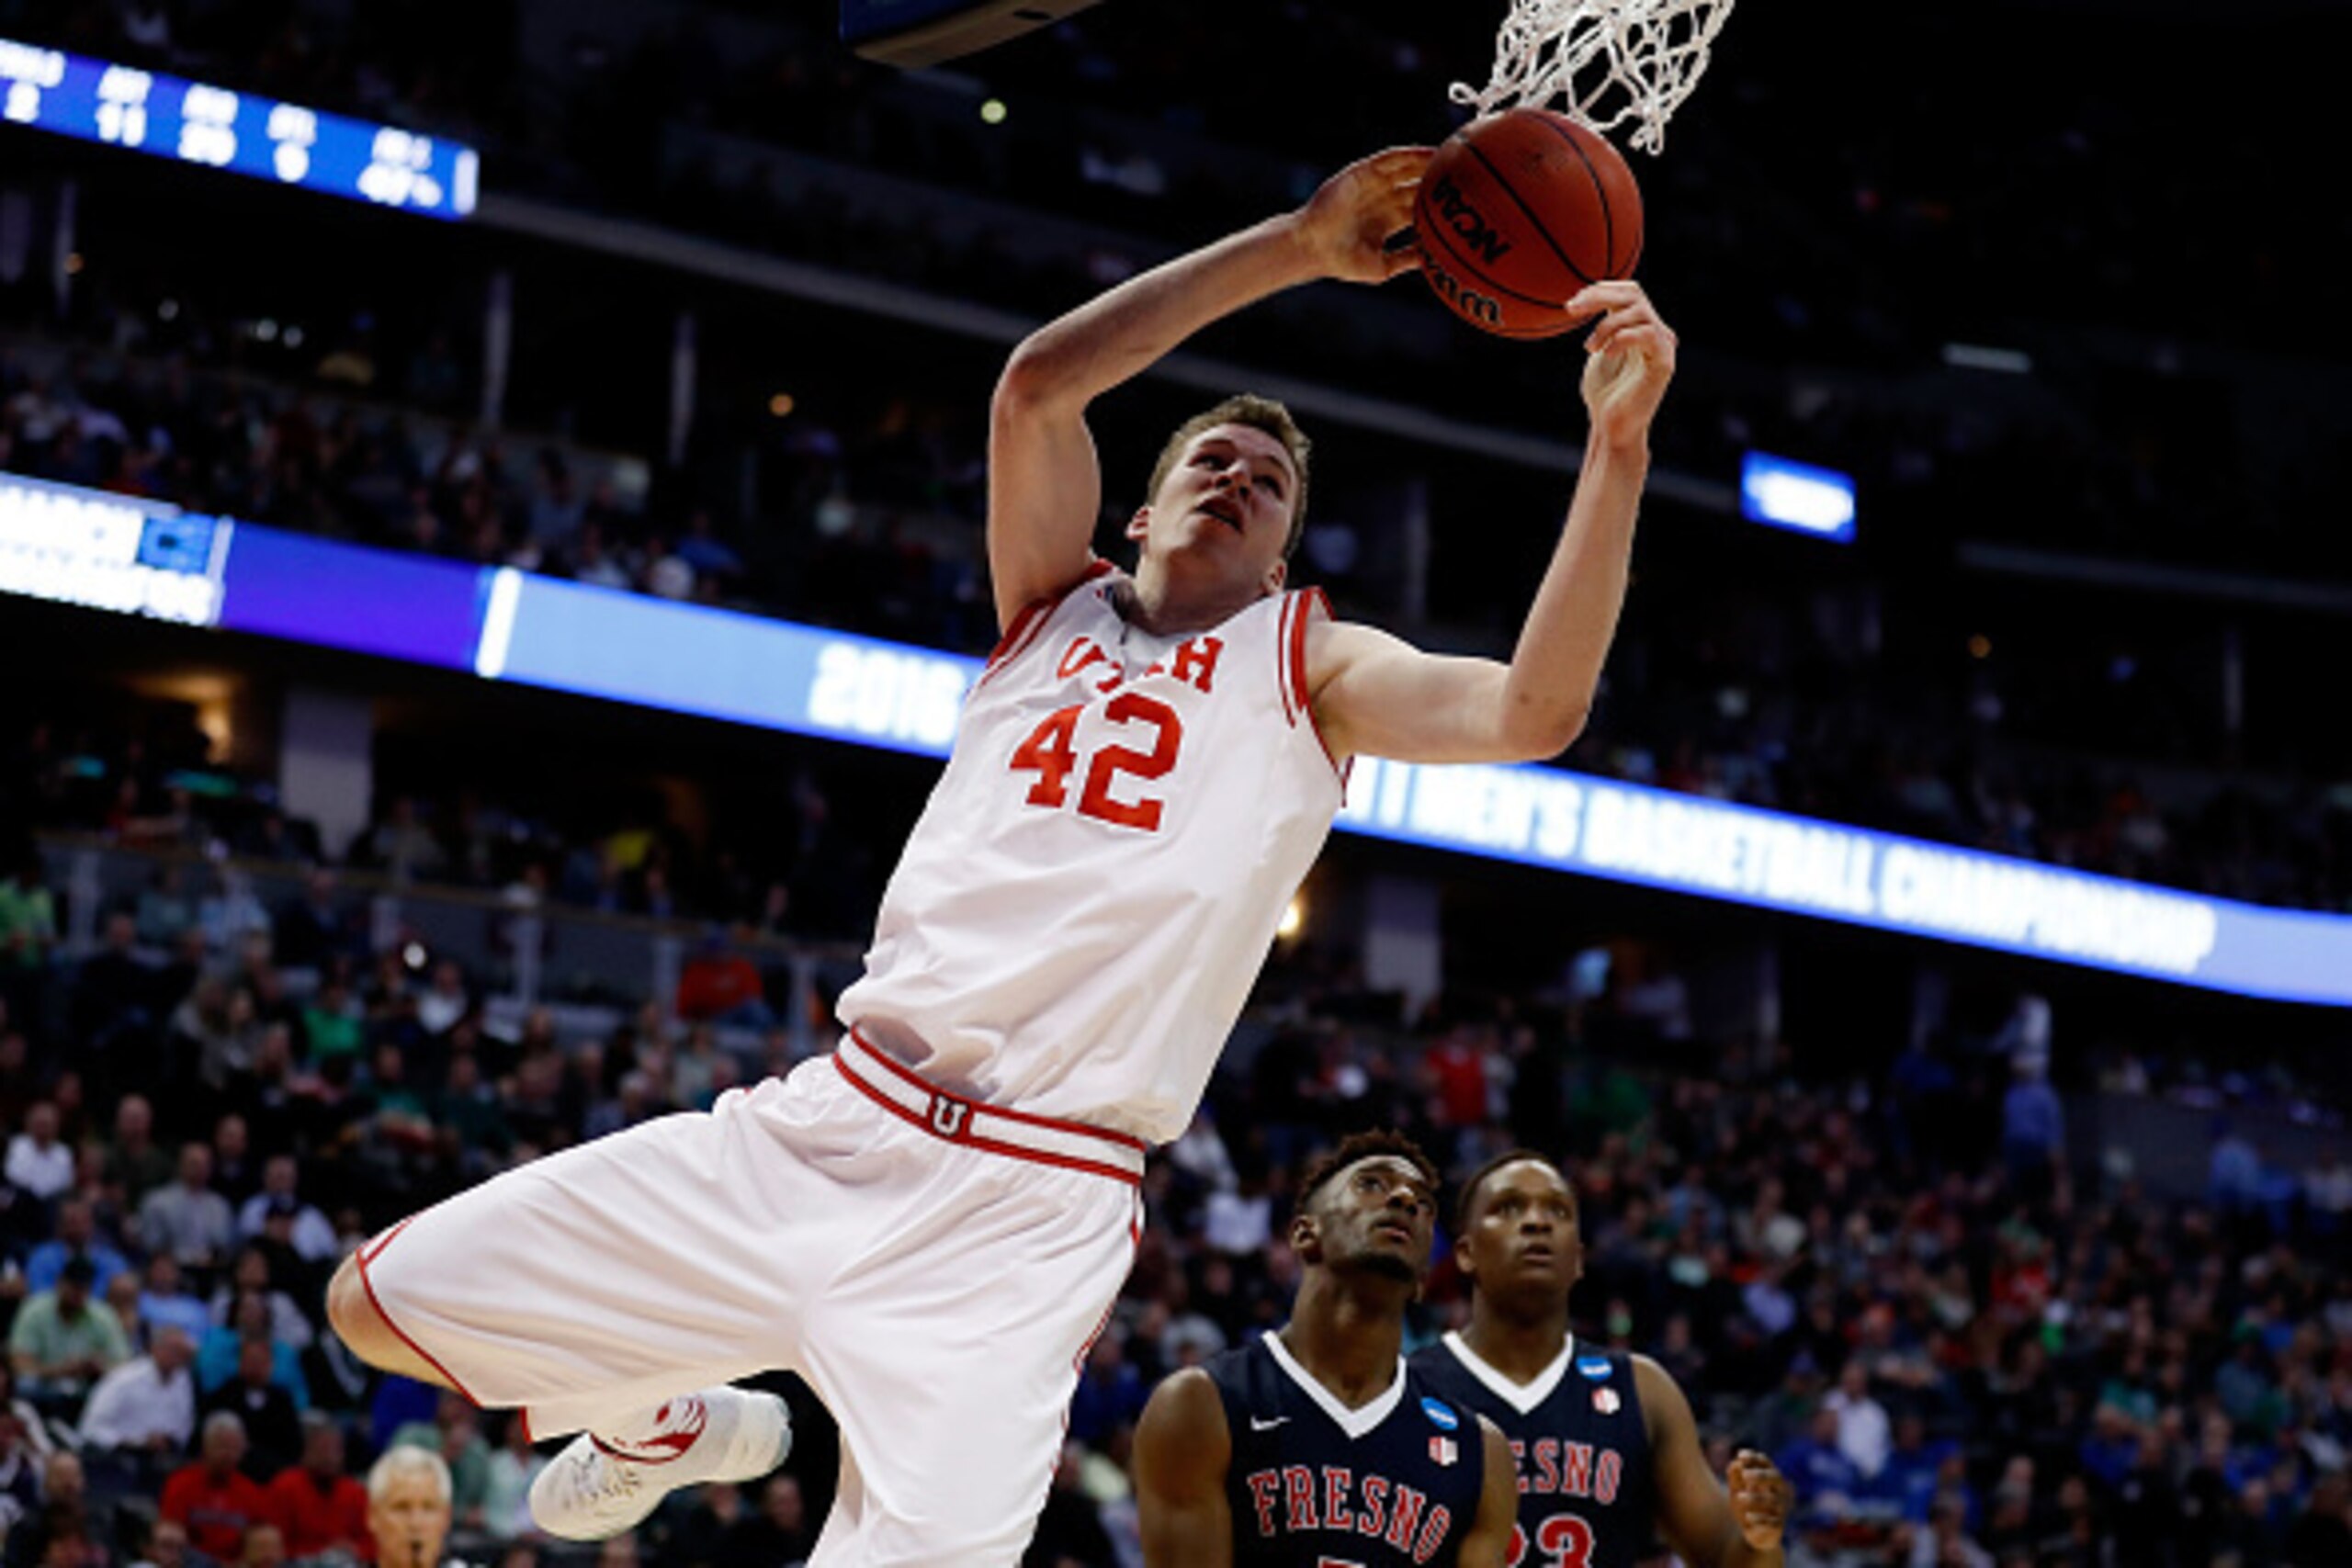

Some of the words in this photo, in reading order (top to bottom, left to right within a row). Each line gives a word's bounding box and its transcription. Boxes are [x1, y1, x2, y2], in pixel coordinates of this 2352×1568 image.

[1430, 175, 1513, 265] NCAA
[1008, 691, 1183, 833] 42
[1412, 761, 1580, 860] MEN'S
[1582, 786, 1874, 917] BASKETBALL
[1881, 843, 2217, 976] CHAMPIONSHIP
[933, 1094, 968, 1137] U
[1247, 1463, 1451, 1564] FRESNO
[1505, 1512, 1596, 1568] 3
